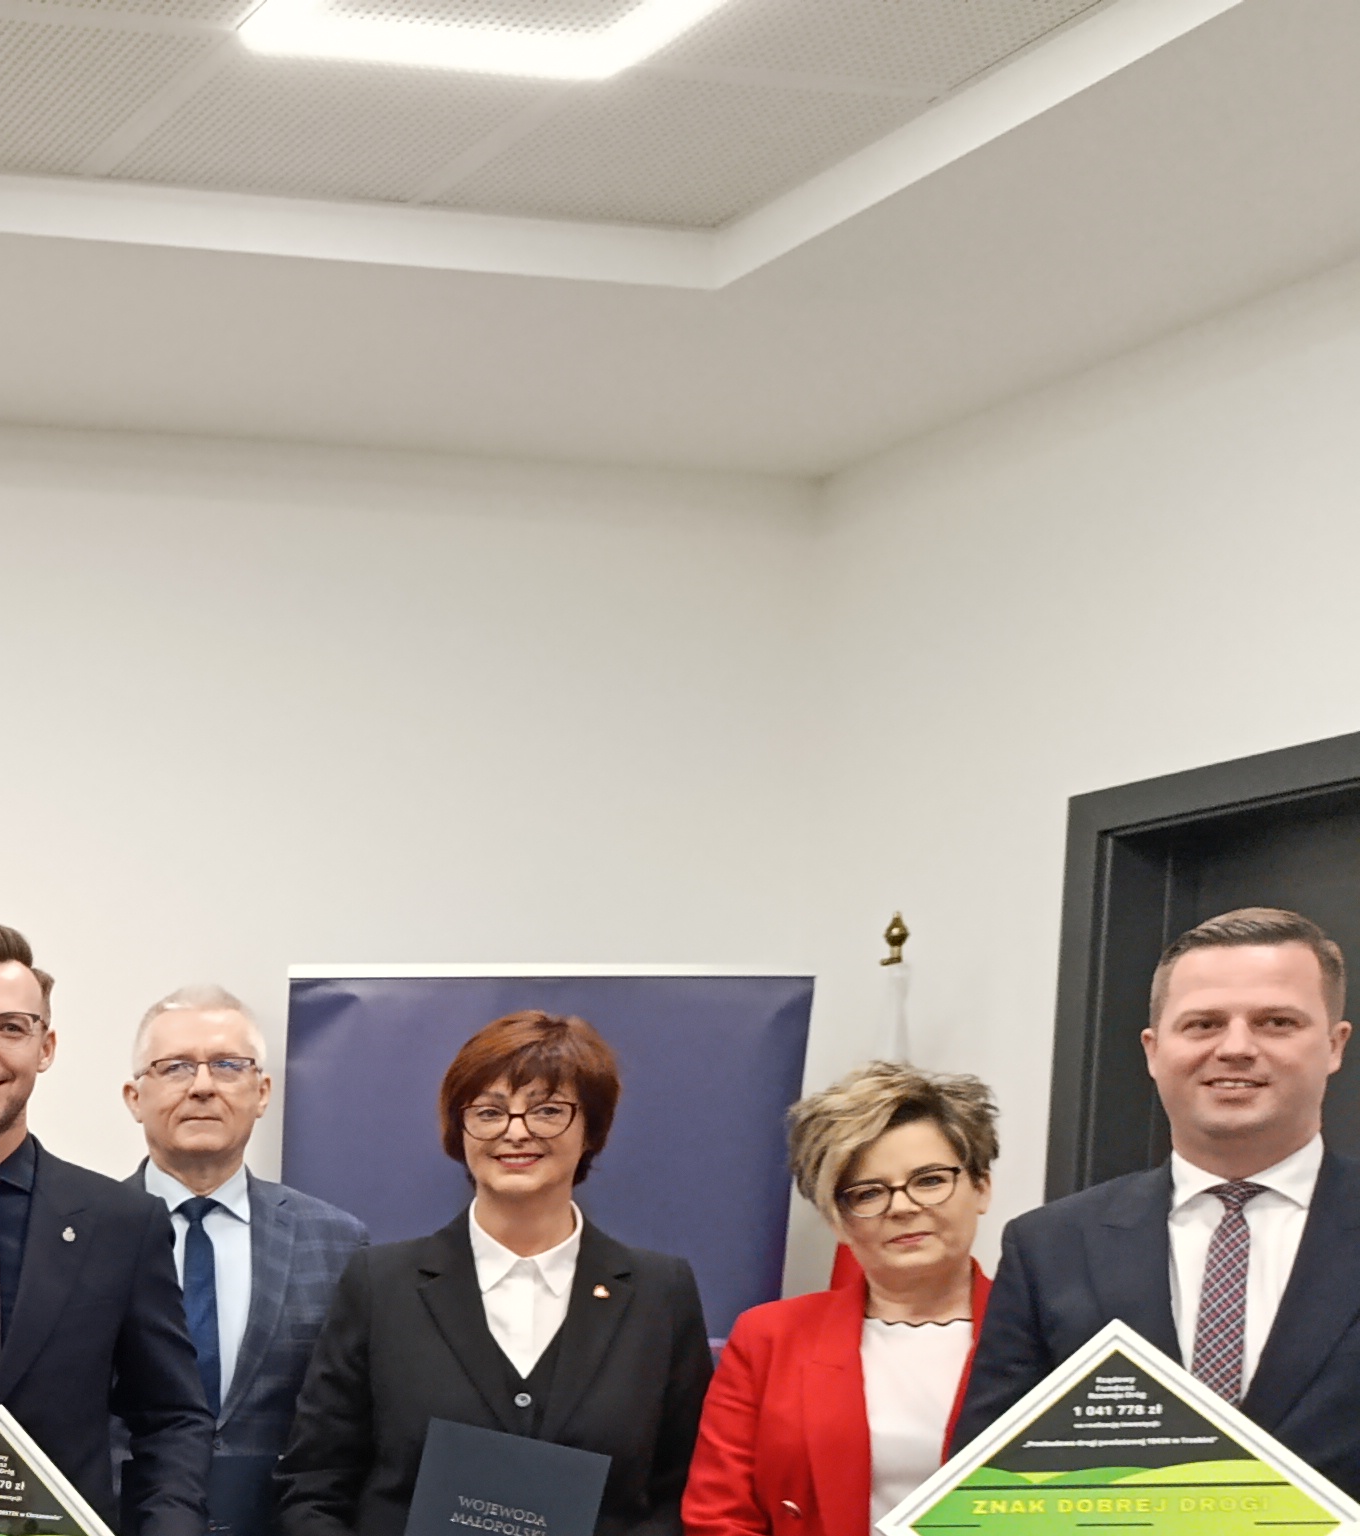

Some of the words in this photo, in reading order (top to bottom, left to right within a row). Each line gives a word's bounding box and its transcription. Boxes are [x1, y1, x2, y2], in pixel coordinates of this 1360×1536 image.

[1072, 1406, 1082, 1416] 1
[1086, 1405, 1113, 1417] 041
[1116, 1405, 1145, 1416] 778
[458, 1495, 547, 1527] WOJEWODA
[972, 1499, 1045, 1515] ZNAK
[1057, 1498, 1168, 1514] DOBREJ
[1179, 1496, 1271, 1513] DROGI
